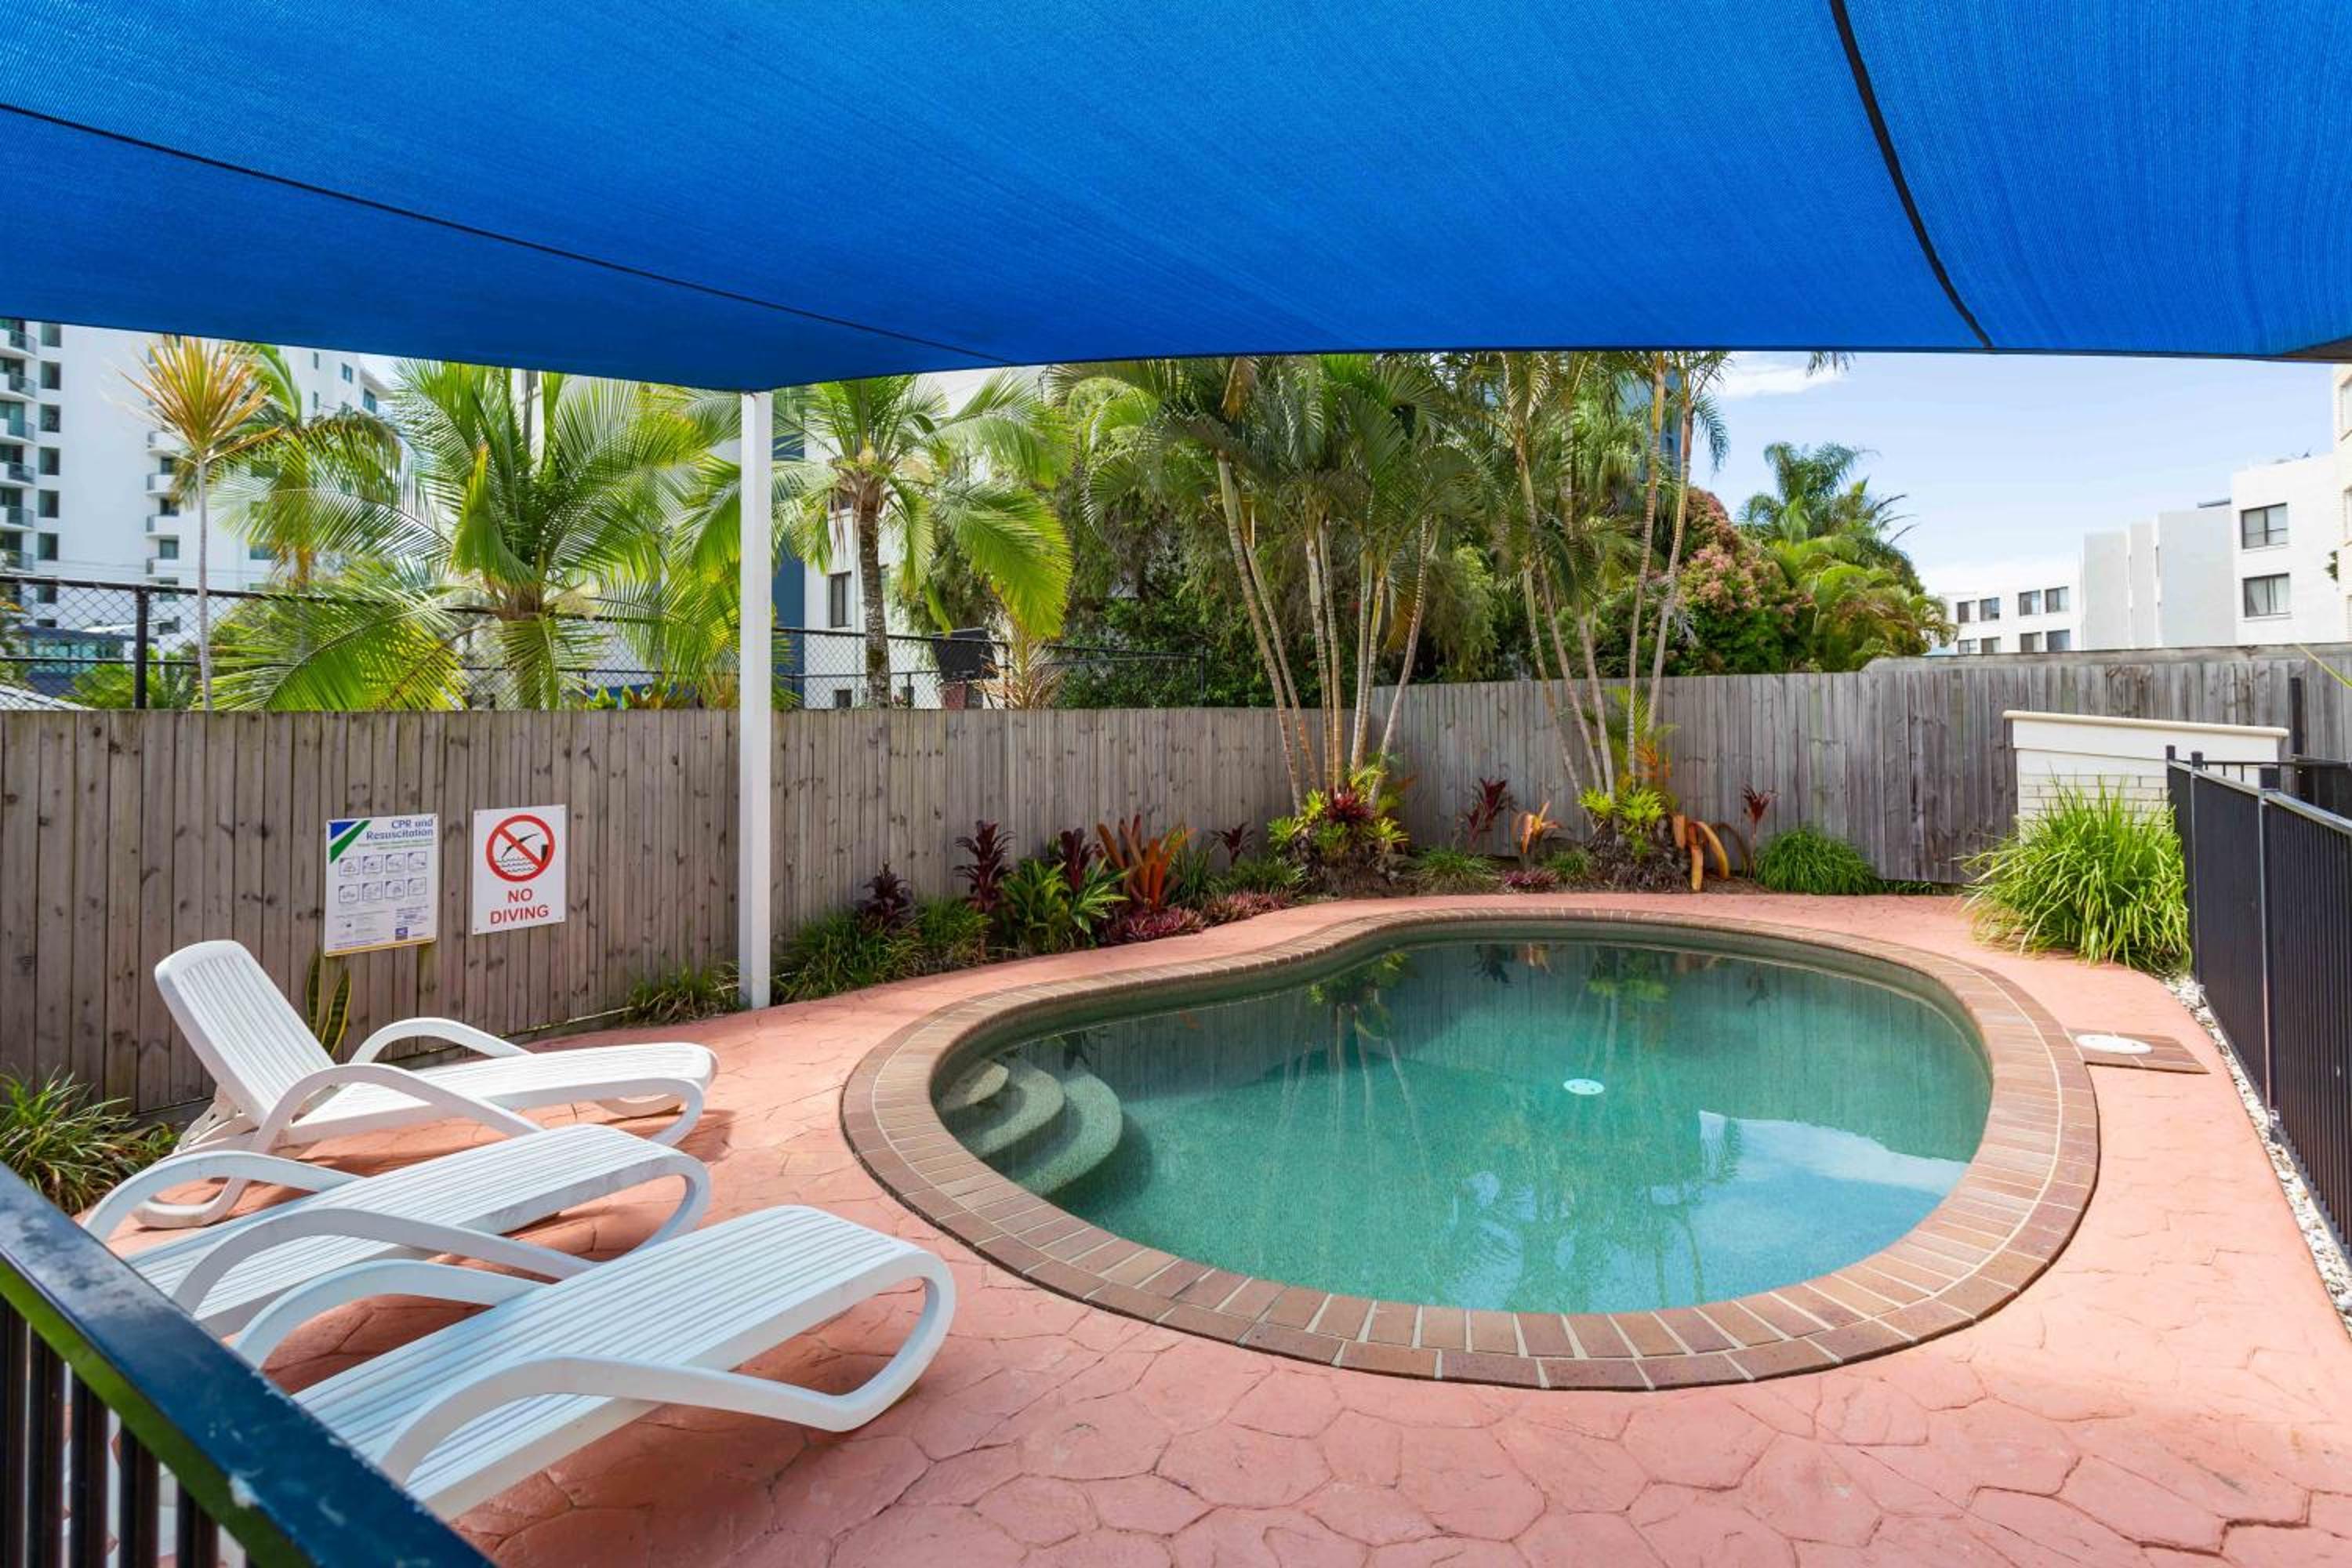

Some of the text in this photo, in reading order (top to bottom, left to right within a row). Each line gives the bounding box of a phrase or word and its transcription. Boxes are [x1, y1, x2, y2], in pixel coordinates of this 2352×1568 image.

[391, 818, 434, 829] CPR and
[365, 829, 434, 840] Resuscitation
[507, 887, 533, 903] NO
[490, 904, 550, 924] DIVING
